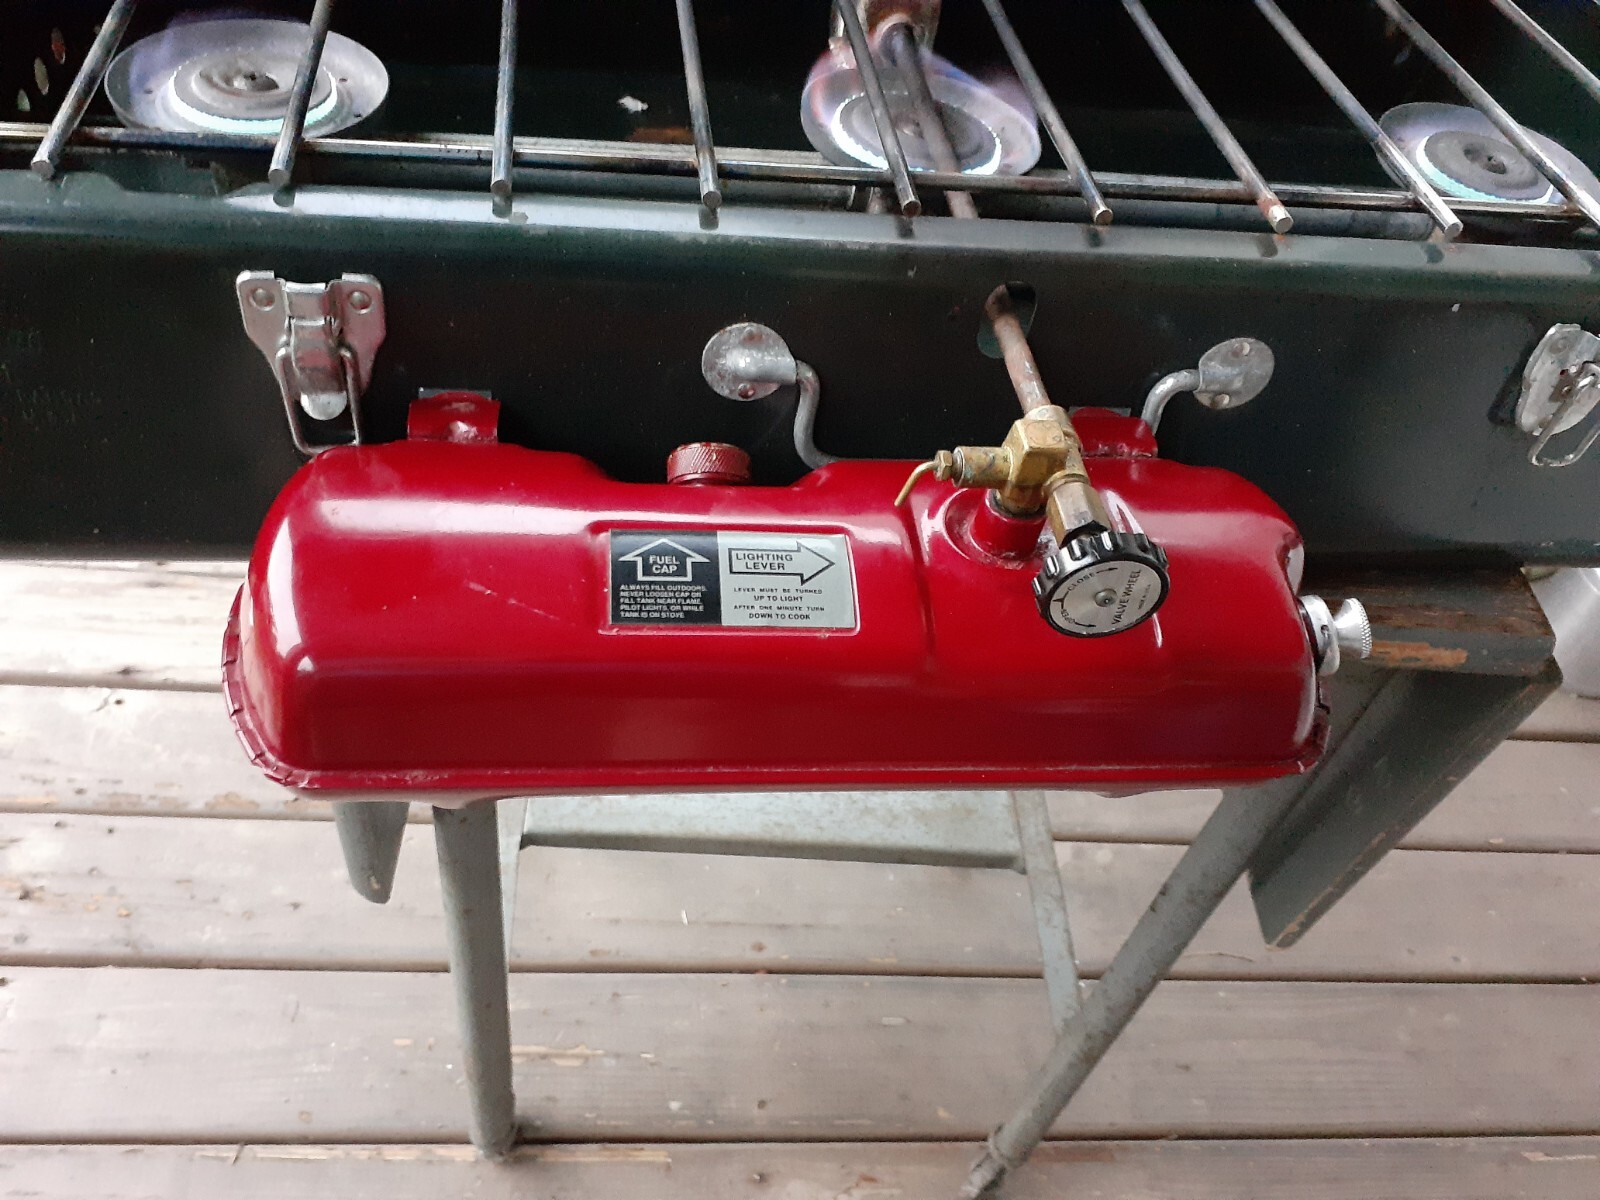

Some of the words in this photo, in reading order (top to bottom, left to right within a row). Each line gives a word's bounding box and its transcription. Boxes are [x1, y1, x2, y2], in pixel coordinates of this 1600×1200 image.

[649, 555, 680, 564] FUEL
[736, 552, 793, 562] LIGHTING
[652, 565, 678, 574] CAP
[746, 562, 786, 570] LEVER
[1067, 572, 1096, 592] CLOSE
[1122, 570, 1142, 598] WHEEL
[1112, 597, 1130, 625] VALVE
